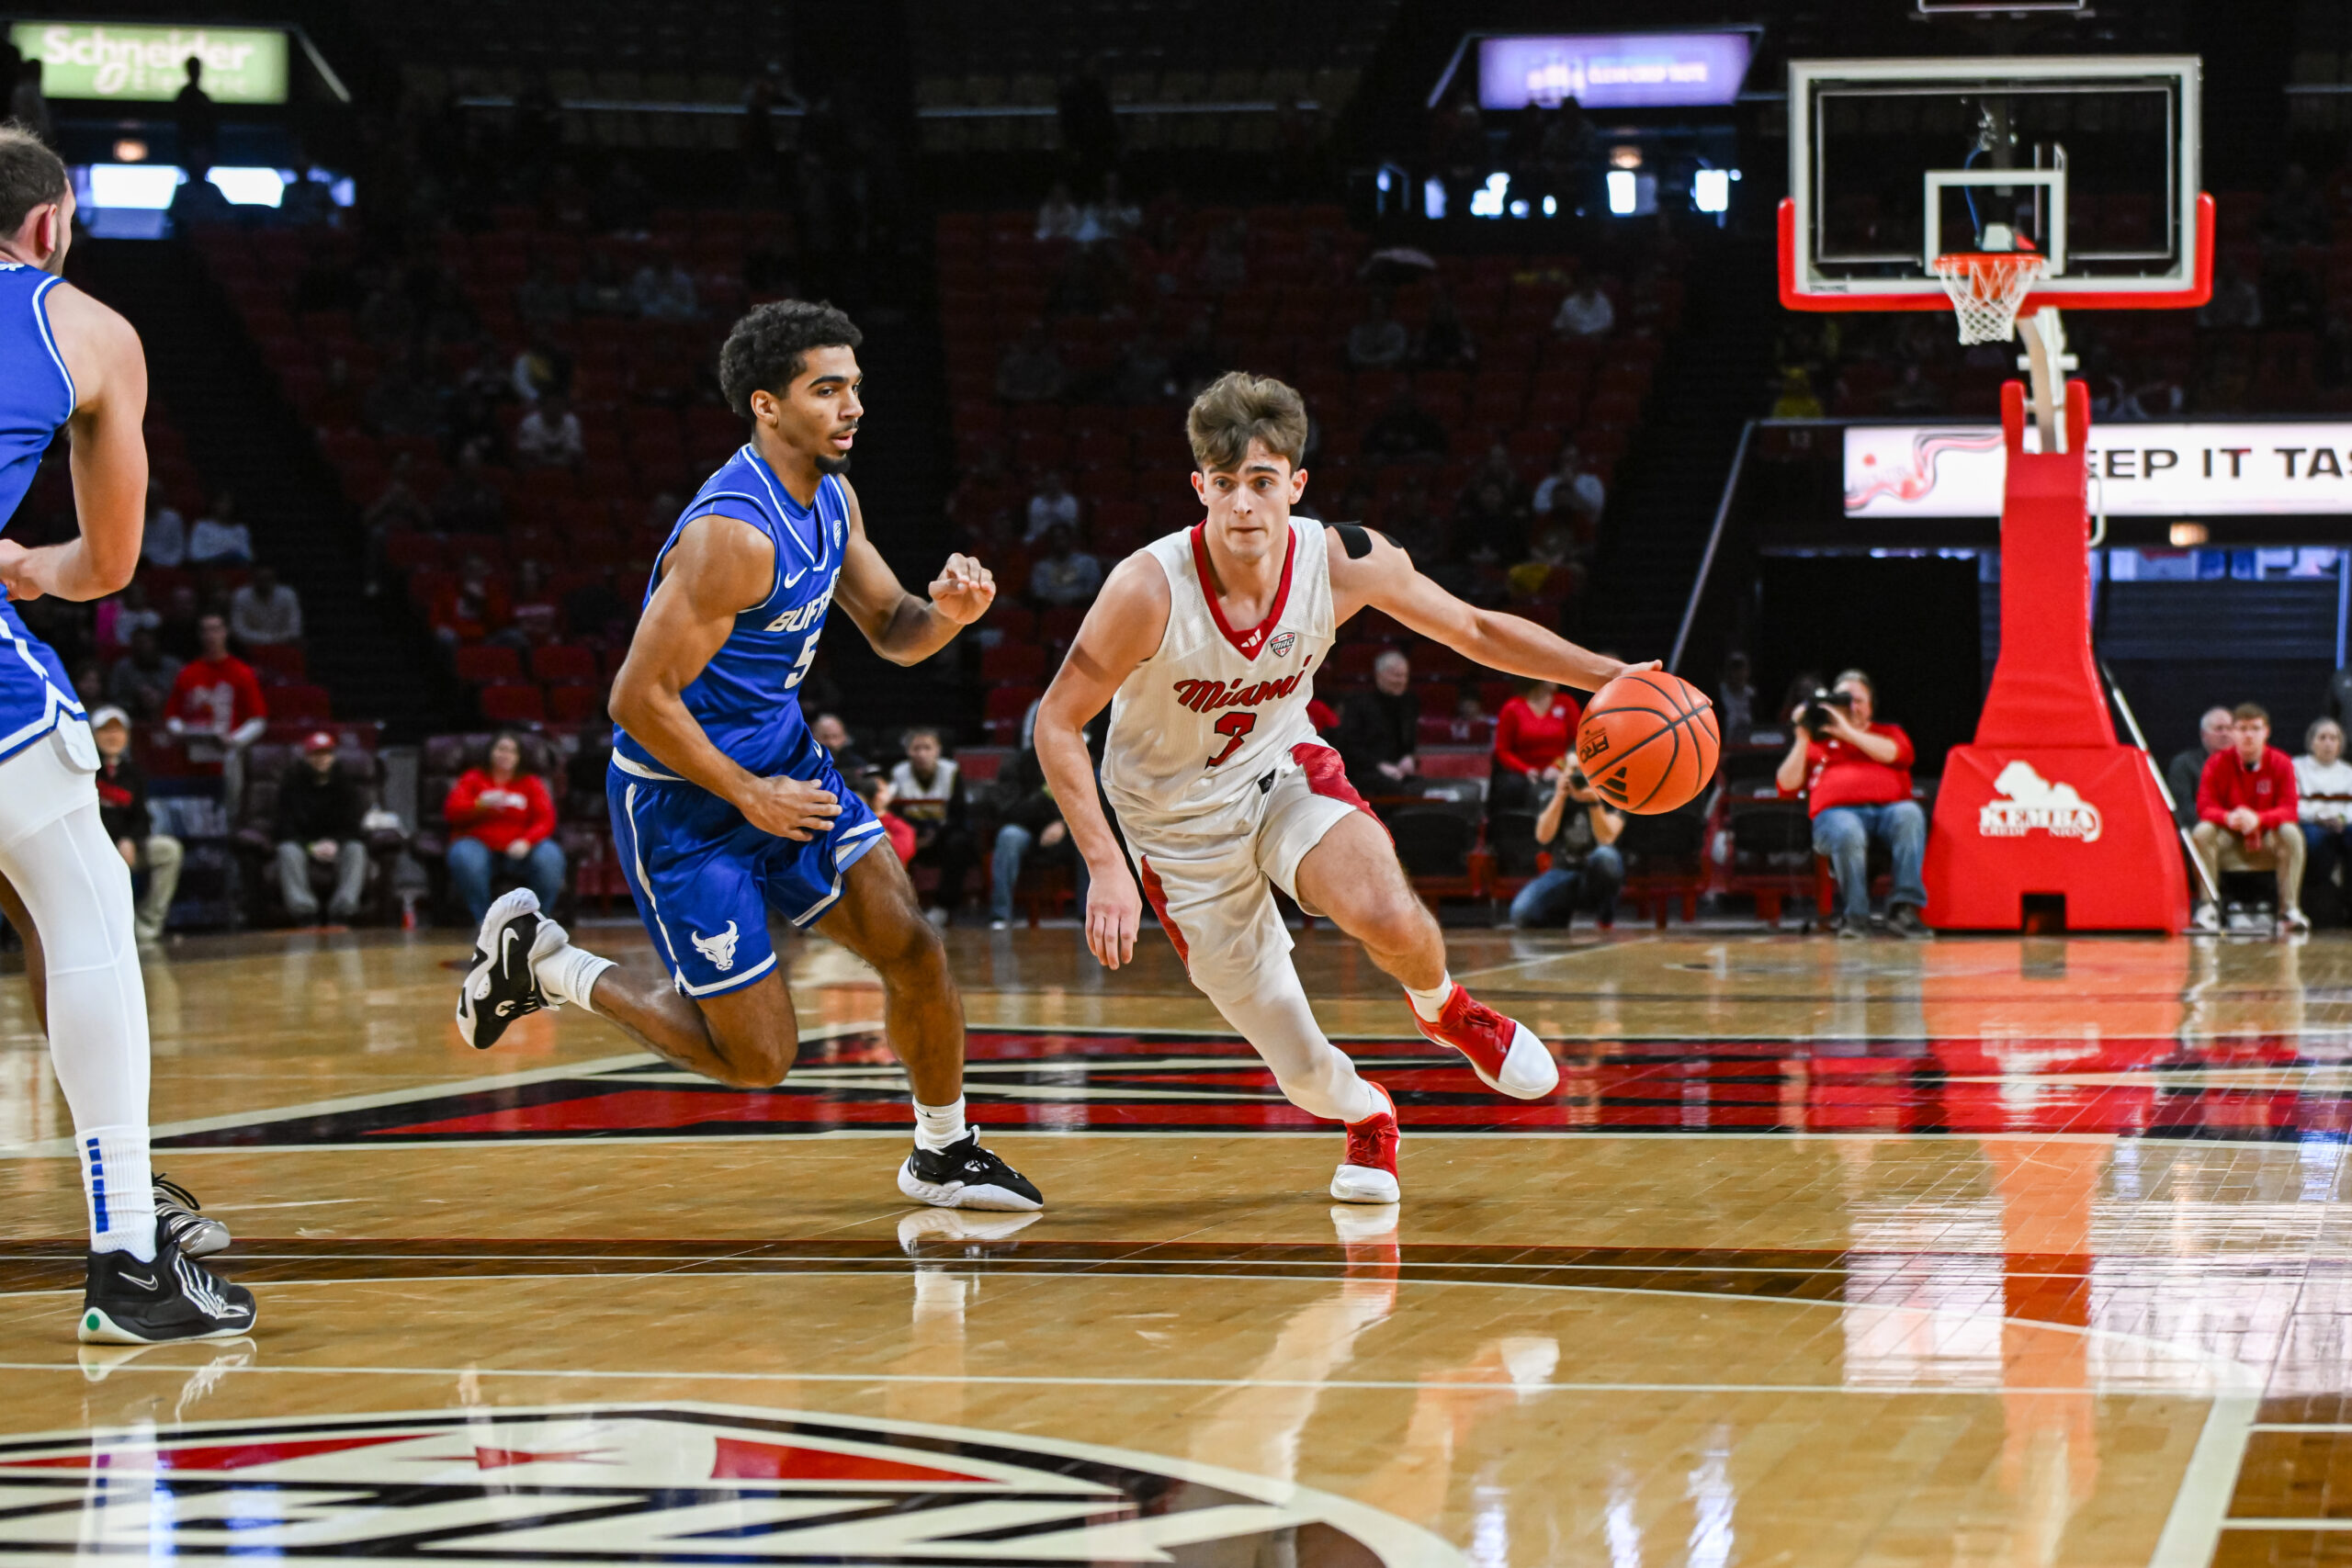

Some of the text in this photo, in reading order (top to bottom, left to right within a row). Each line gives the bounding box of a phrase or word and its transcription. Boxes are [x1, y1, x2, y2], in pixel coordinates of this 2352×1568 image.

[43, 27, 253, 70] Schneider
[2088, 447, 2352, 479] EP IT TA
[784, 627, 822, 689] 5
[1173, 653, 1313, 714] Miami
[1979, 807, 2094, 828] KEMBA
